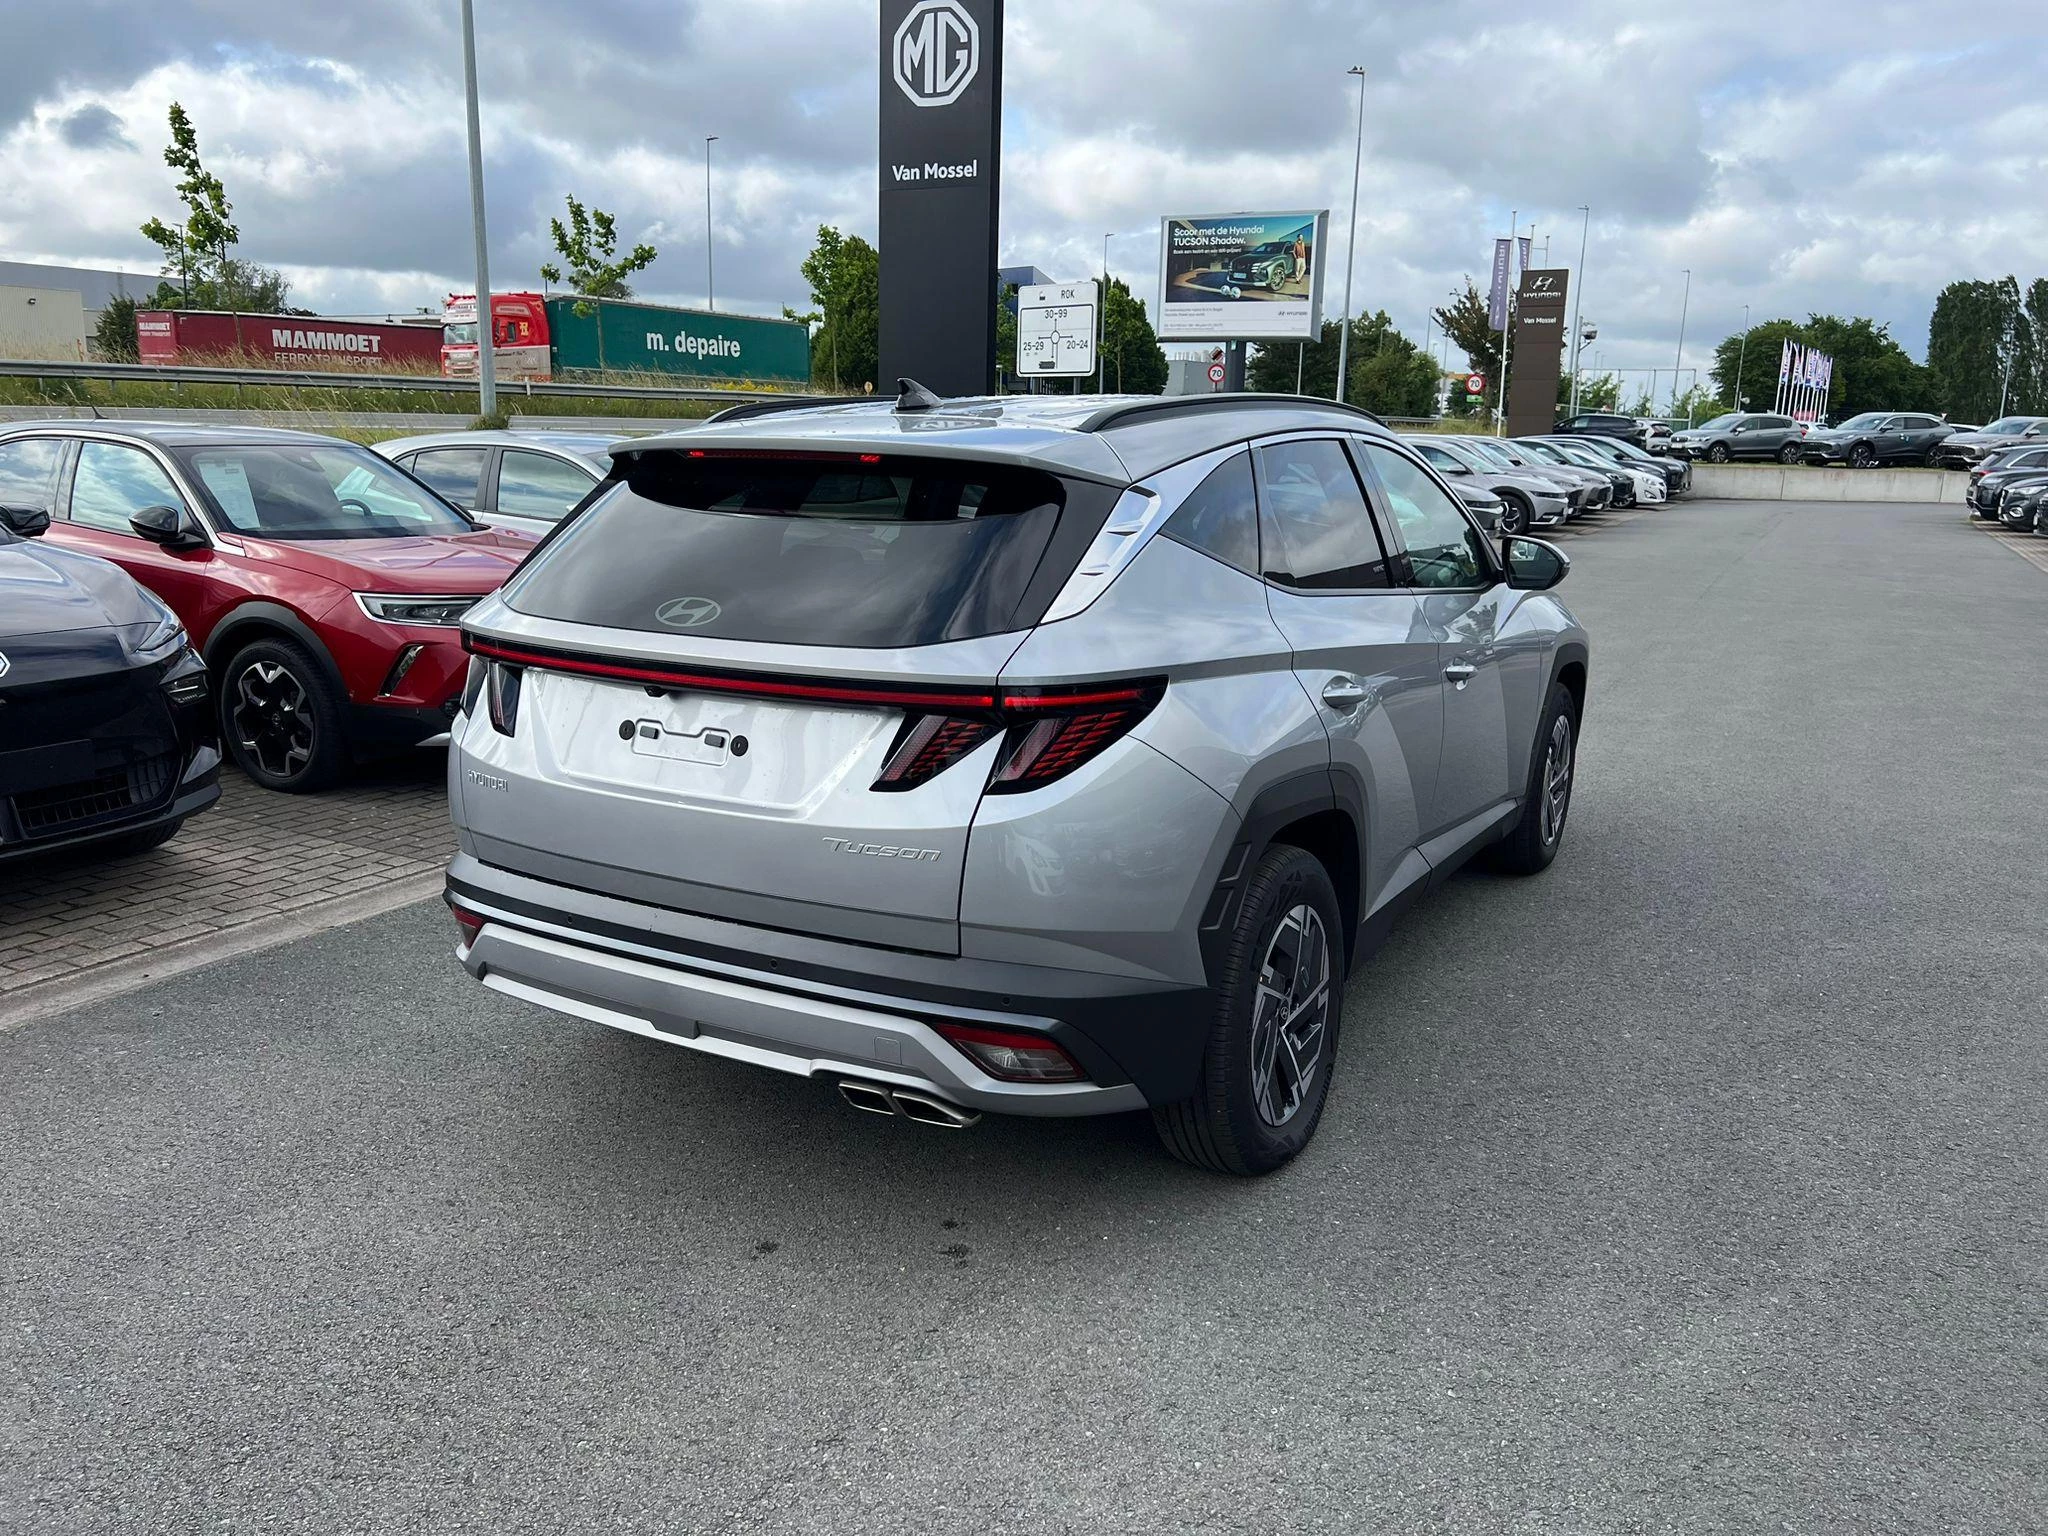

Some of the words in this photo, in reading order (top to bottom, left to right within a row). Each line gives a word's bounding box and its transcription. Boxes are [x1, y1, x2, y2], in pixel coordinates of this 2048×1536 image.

[903, 11, 969, 94] MG
[892, 165, 920, 182] Van
[924, 159, 978, 180] Mossel
[1174, 228, 1197, 236] Scoor
[1199, 227, 1215, 236] met
[1217, 226, 1228, 235] de
[1229, 225, 1265, 236] Hyundai
[1173, 237, 1209, 246] TUCSON
[1210, 236, 1246, 245] Shadow.
[1044, 309, 1068, 319] 30-99
[272, 329, 381, 353] MAMMOET
[646, 332, 670, 351] m.
[674, 330, 741, 360] depaire
[1023, 341, 1044, 351] 25-29
[1066, 339, 1088, 349] 20-24
[274, 352, 313, 365] FERRY
[1211, 369, 1222, 377] 70
[1470, 379, 1480, 388] 70
